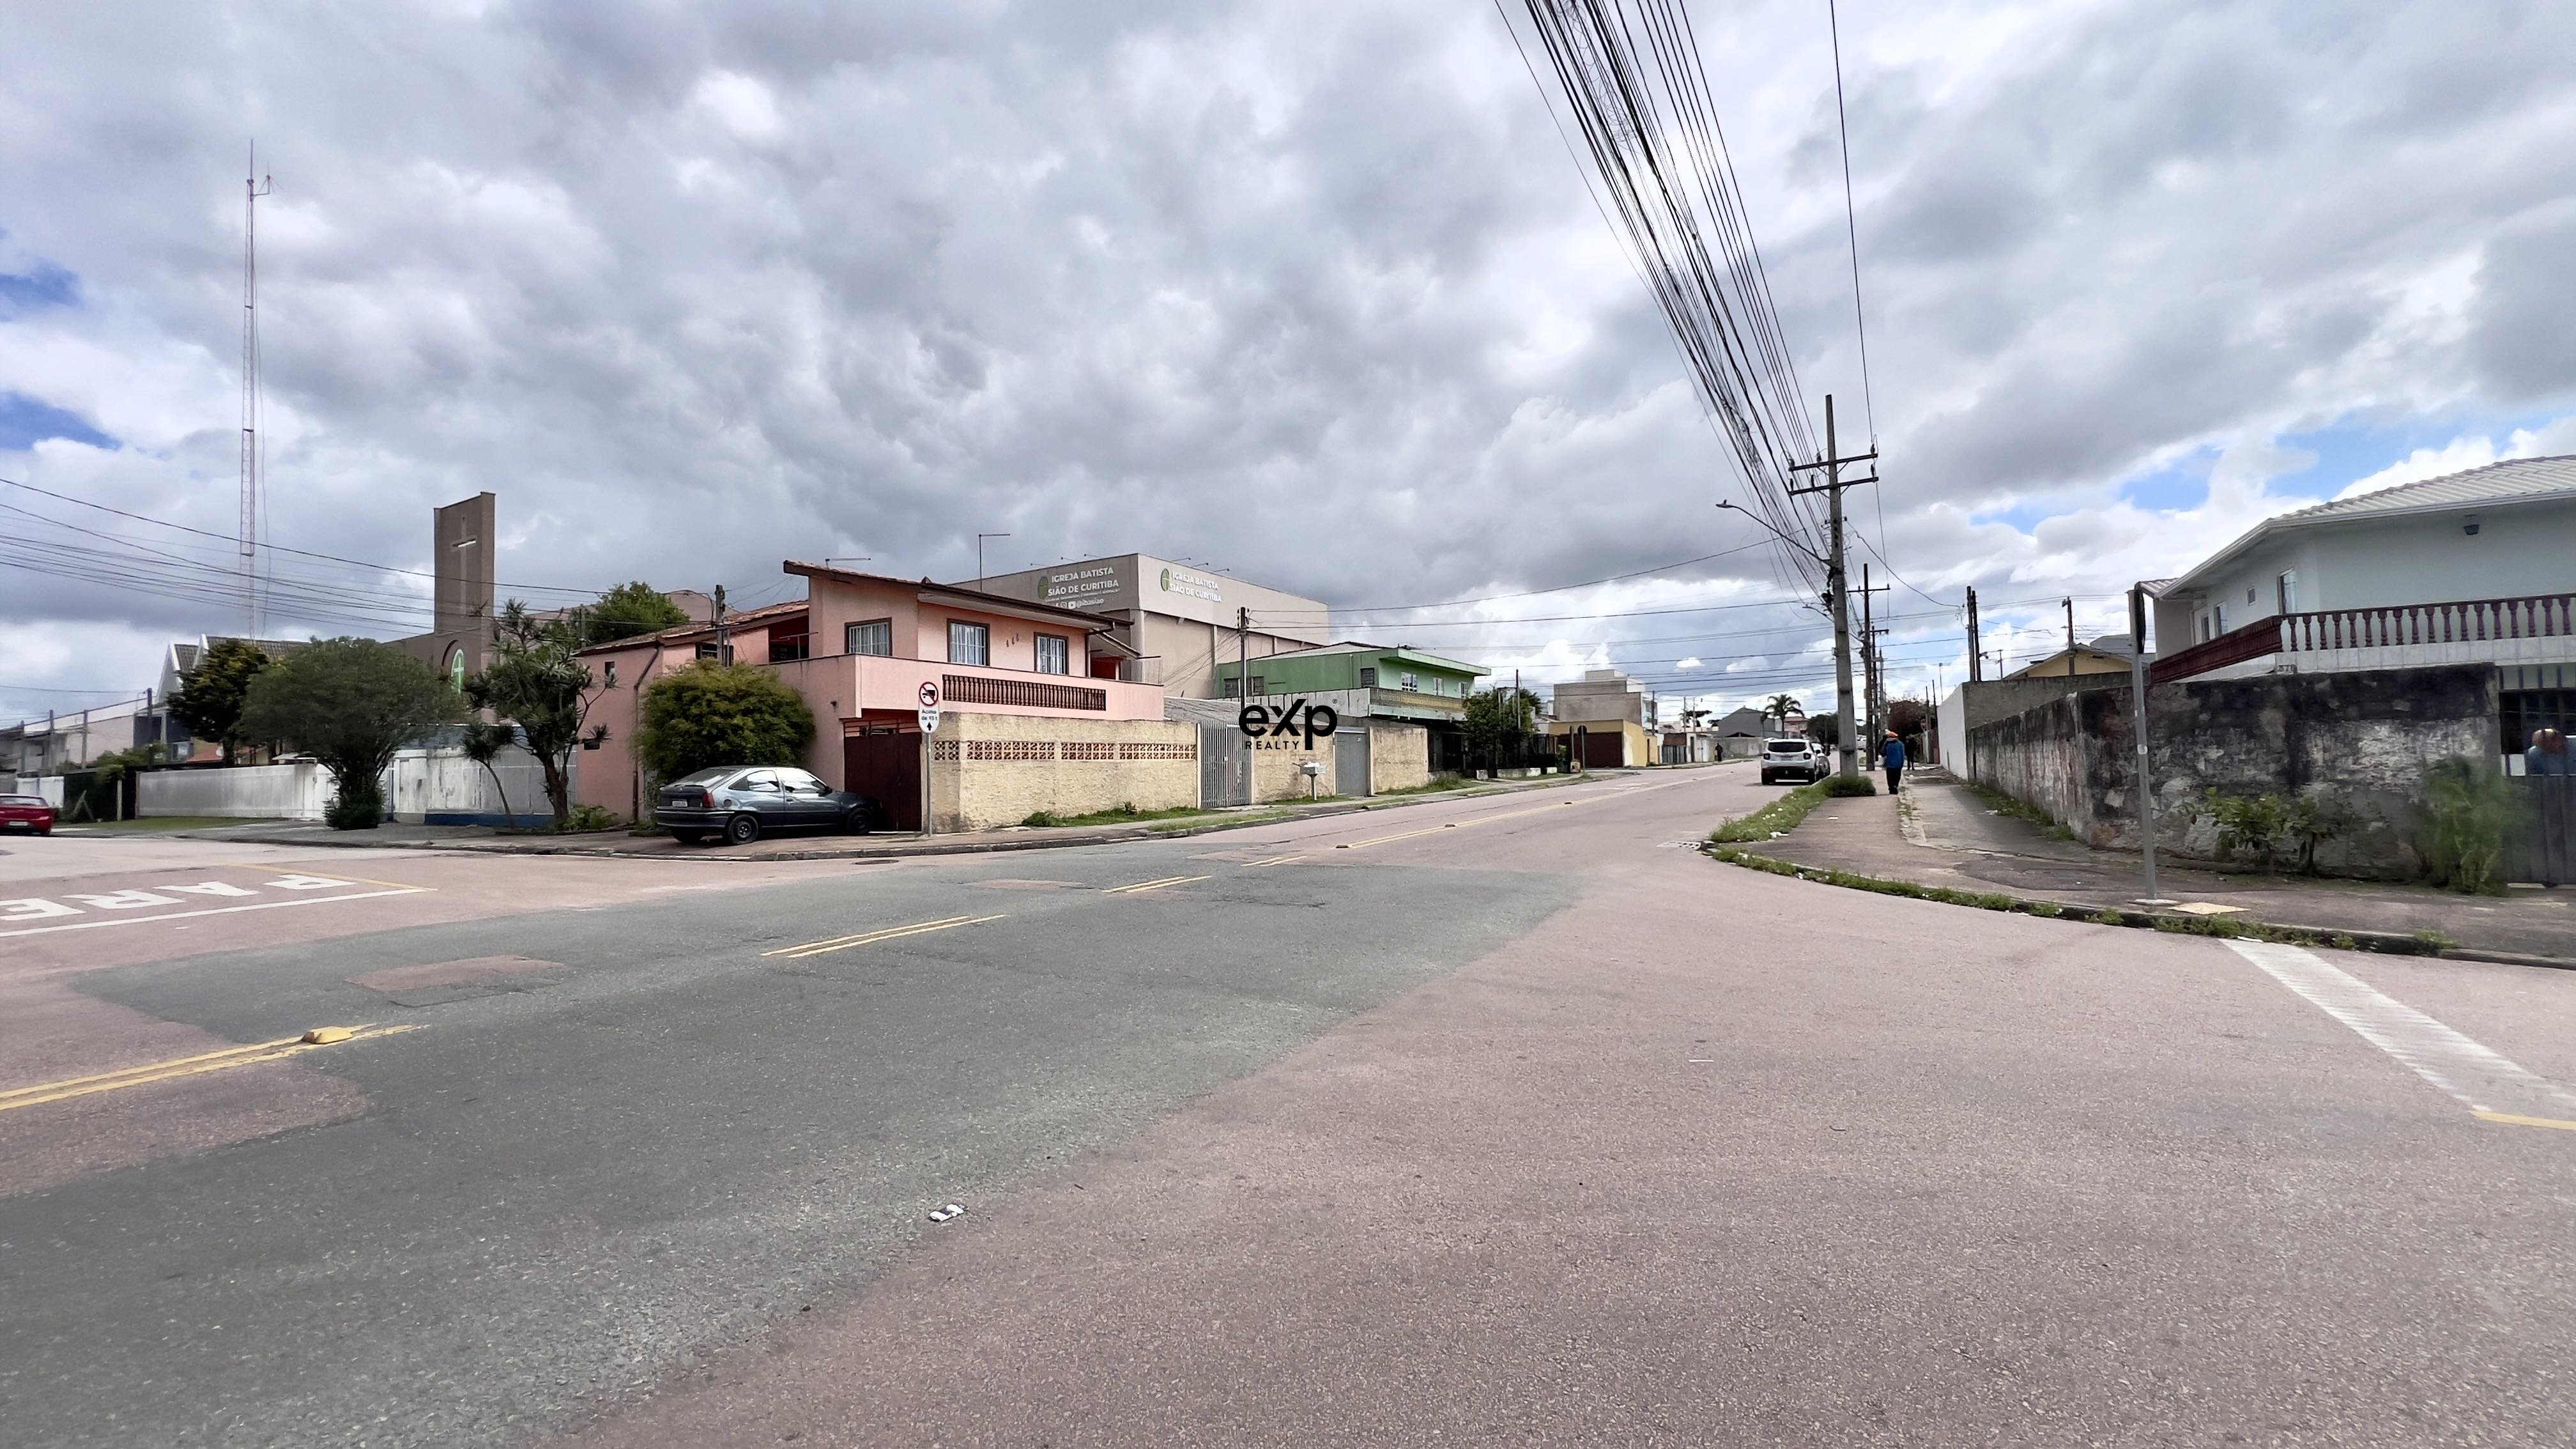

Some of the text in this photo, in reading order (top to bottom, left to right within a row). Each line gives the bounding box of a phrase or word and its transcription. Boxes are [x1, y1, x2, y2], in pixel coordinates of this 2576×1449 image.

[1052, 567, 1114, 583] IGREJA BATISTA
[1172, 571, 1219, 590] IGREJA BATISTA
[1048, 585, 1066, 596] SIÃO
[1068, 584, 1079, 594] DE
[1080, 579, 1119, 592] CURITIBA
[1169, 582, 1222, 602] SIÃO DE CURITIBA
[0, 874, 357, 921] PARE
